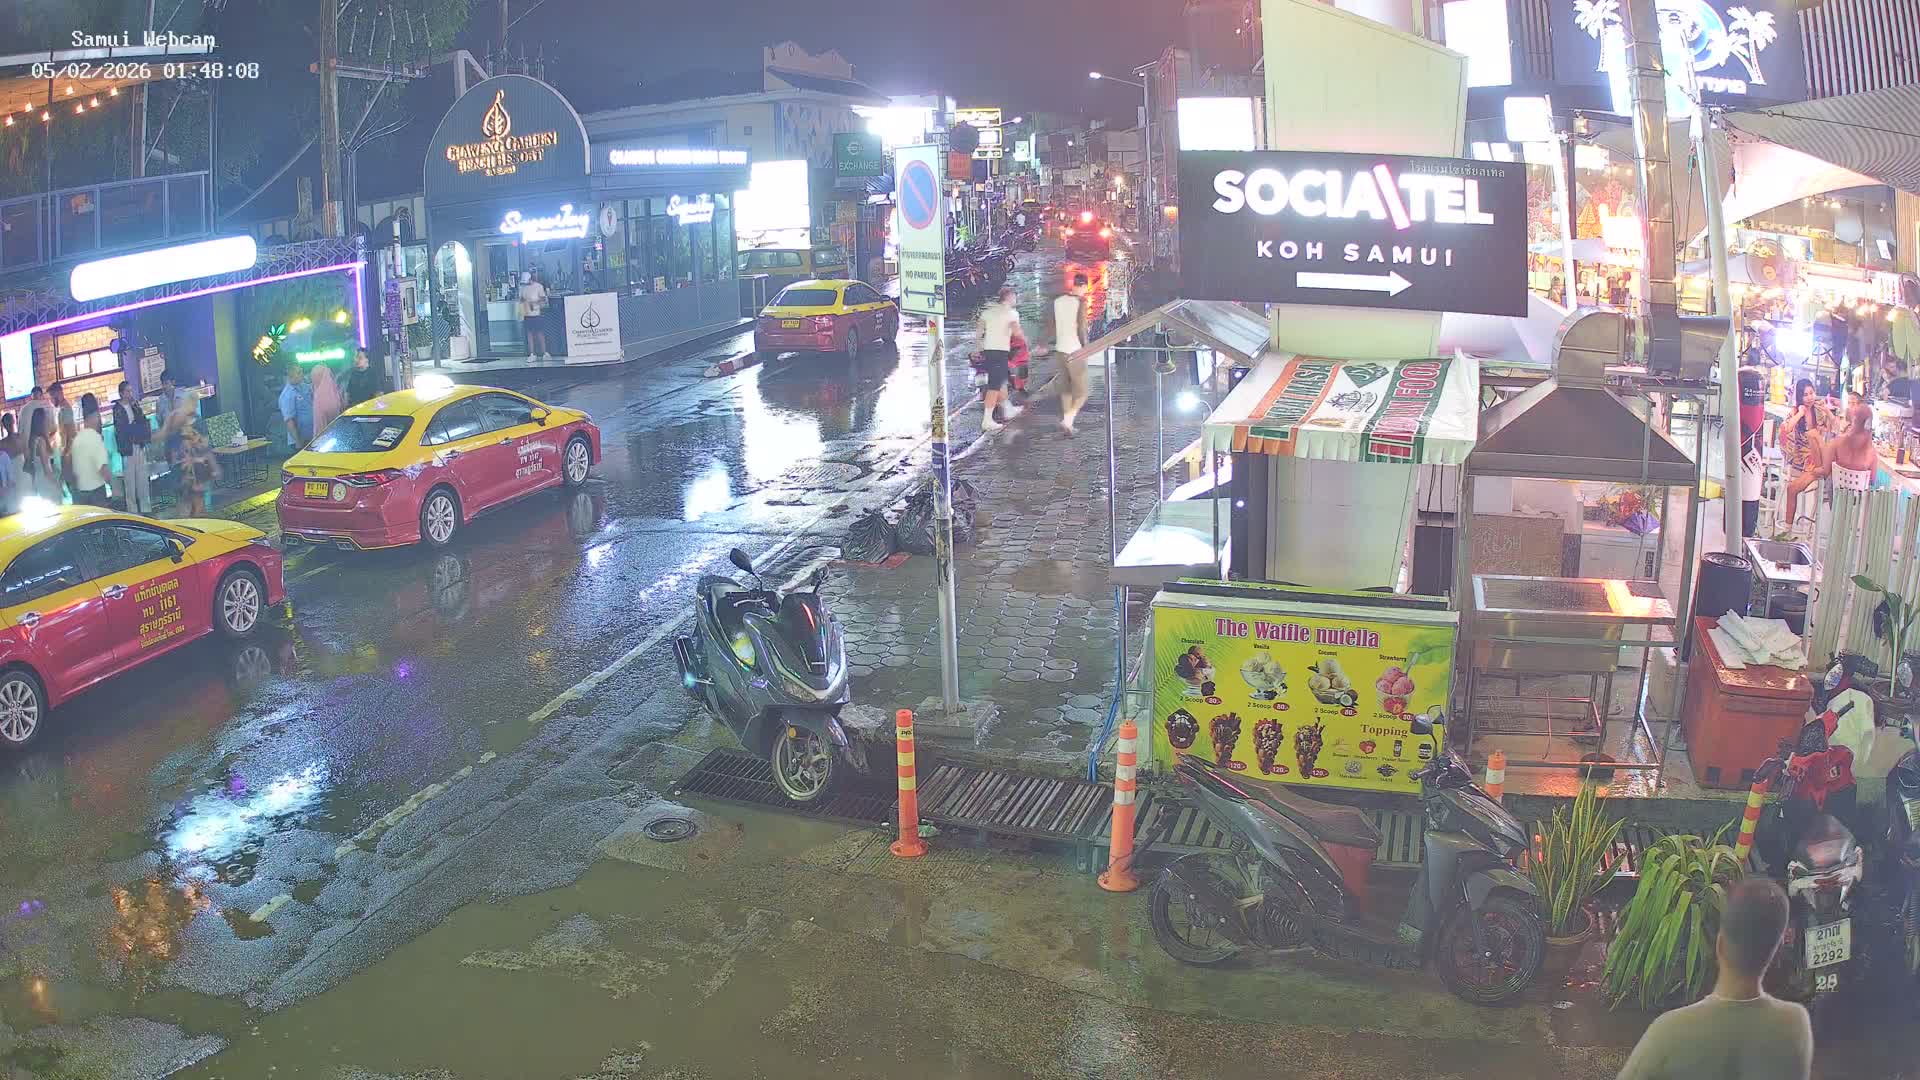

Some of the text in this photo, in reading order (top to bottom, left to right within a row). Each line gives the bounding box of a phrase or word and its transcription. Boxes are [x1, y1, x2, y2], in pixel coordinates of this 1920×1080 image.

[839, 160, 881, 171] EXCHANGE
[1256, 240, 1453, 267] KOH SAMUI
[905, 270, 938, 280] NO PARKING
[1392, 361, 1442, 398] FOOD
[1216, 617, 1380, 650] The Waffle nutella
[1181, 637, 1205, 645] Chocolate
[1378, 654, 1407, 663] Strawberry
[1252, 702, 1271, 710] Scoop
[1361, 724, 1408, 738] Topping
[1813, 948, 1843, 965] 2292
